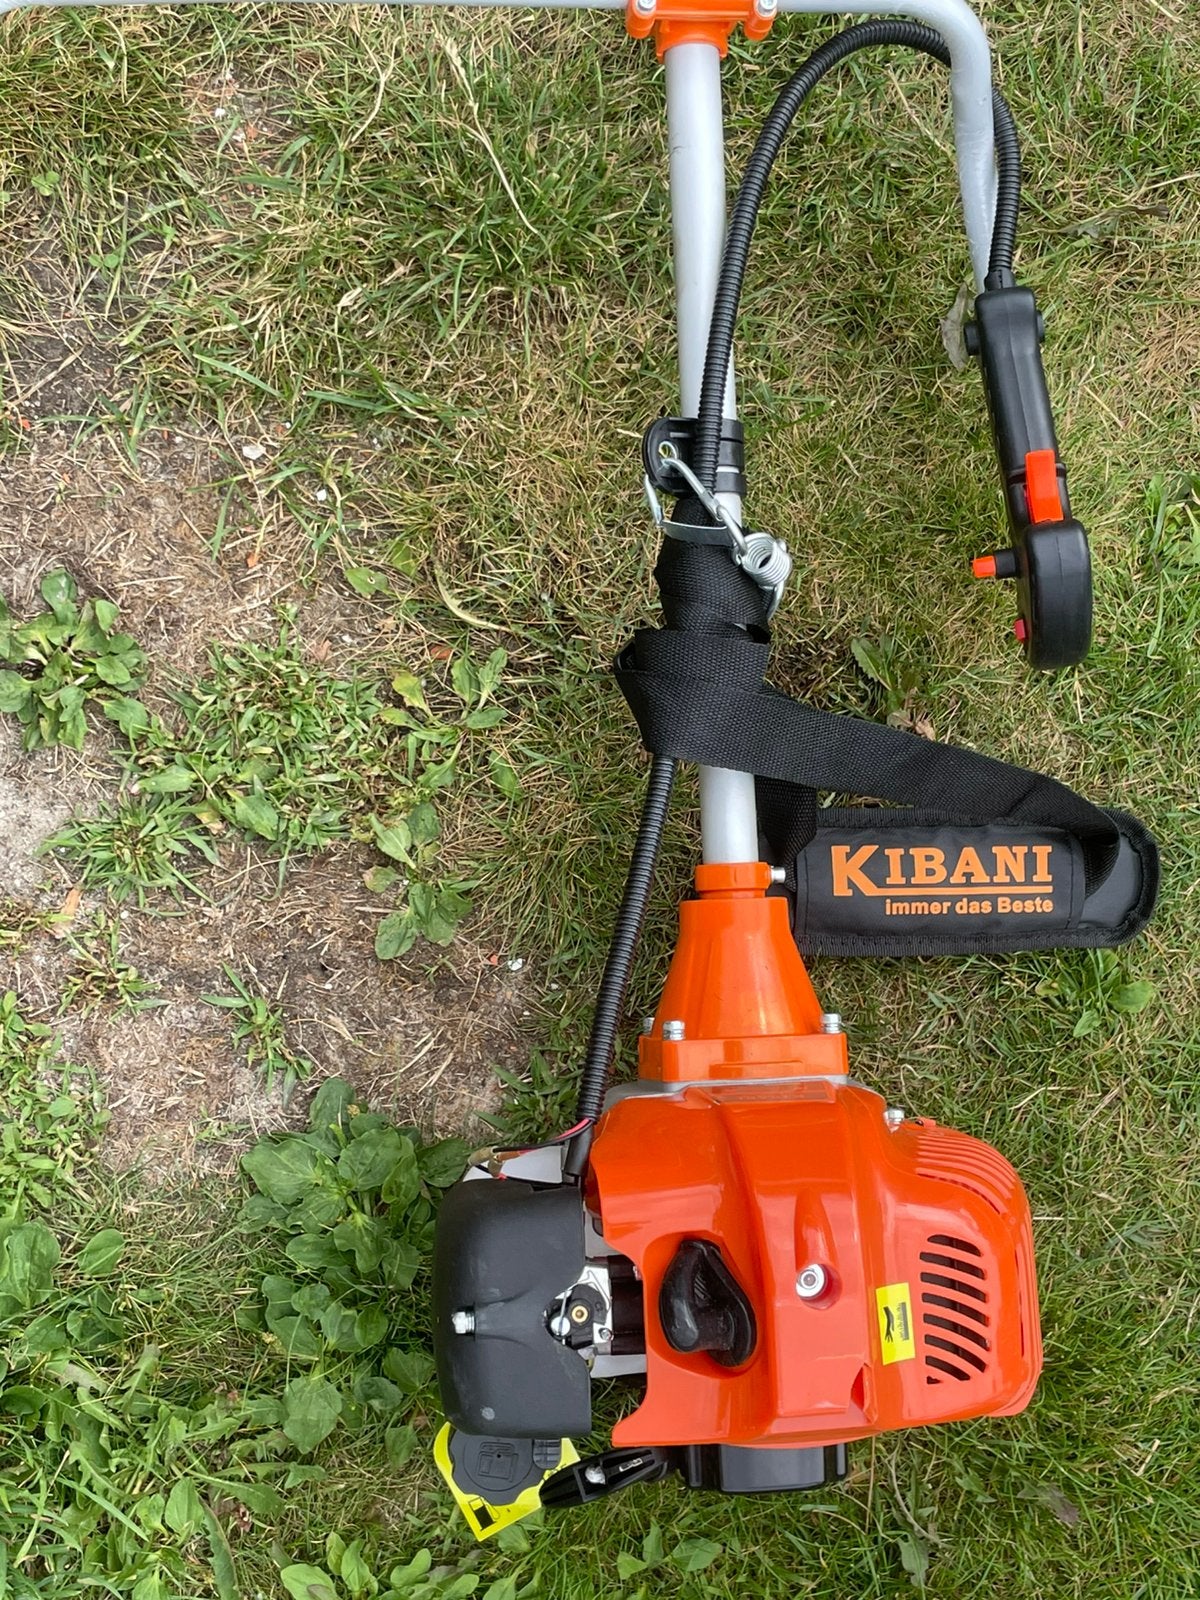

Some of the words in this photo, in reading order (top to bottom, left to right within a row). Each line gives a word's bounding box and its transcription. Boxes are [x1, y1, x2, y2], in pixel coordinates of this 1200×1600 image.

[831, 845, 1053, 896] KIBANI
[886, 899, 951, 915] immer
[955, 898, 992, 914] das
[997, 897, 1053, 913] Beste
